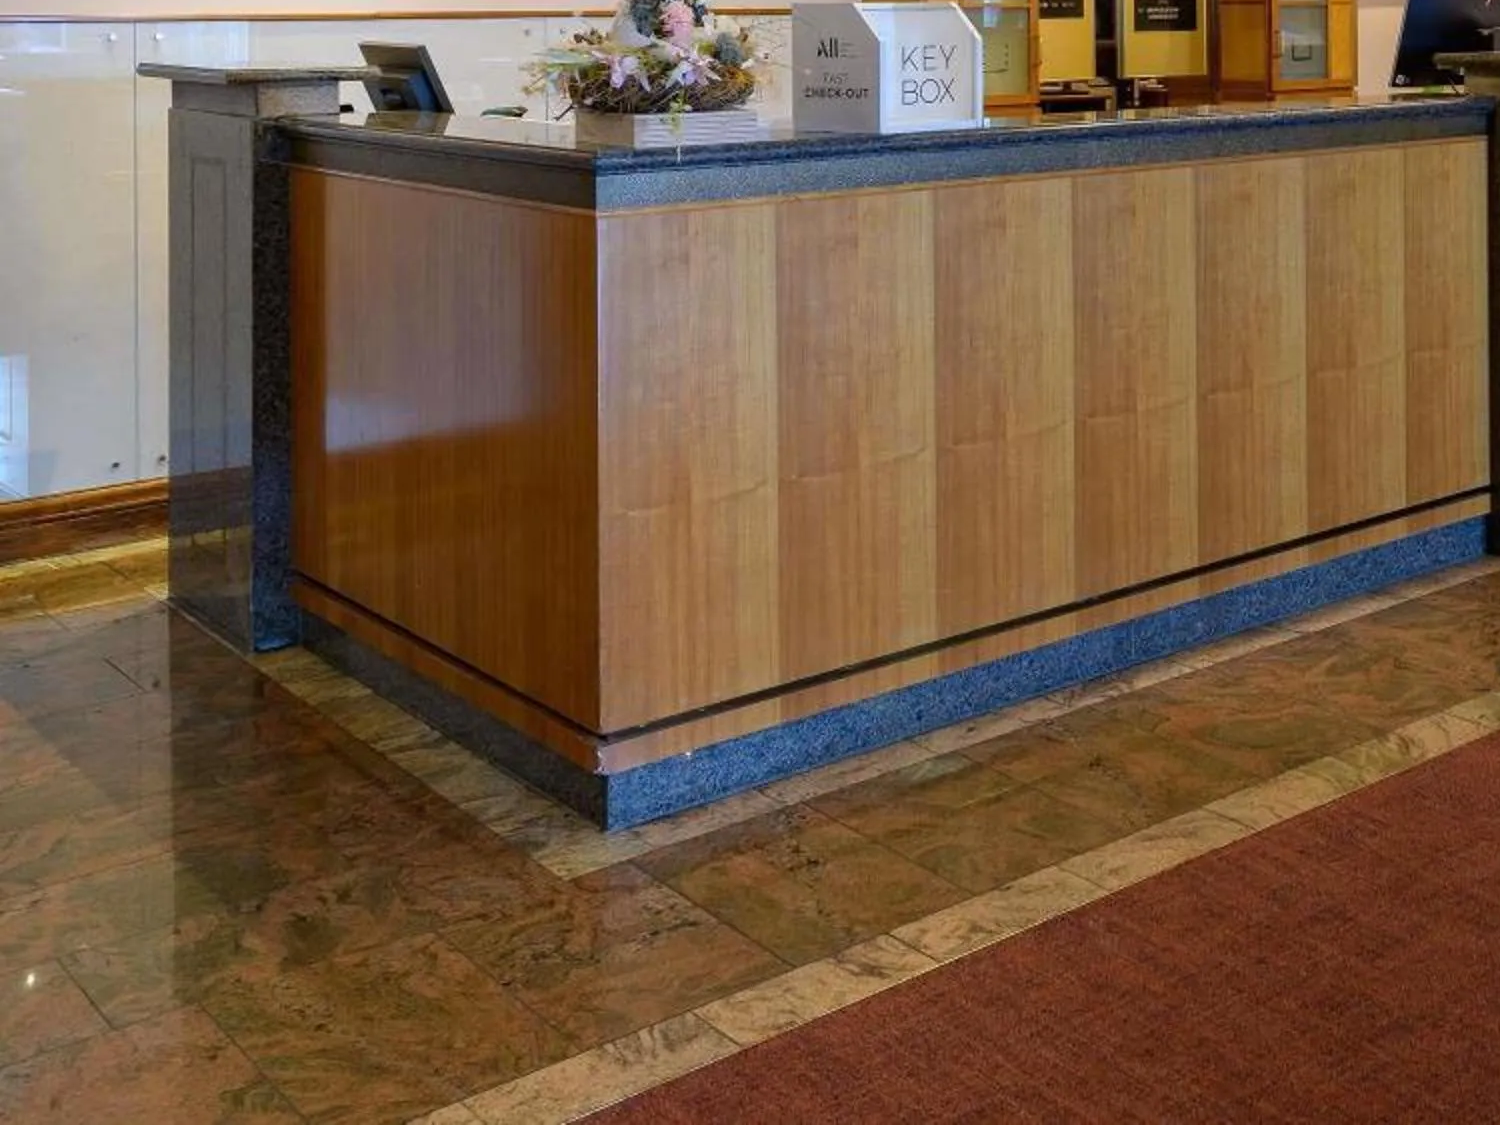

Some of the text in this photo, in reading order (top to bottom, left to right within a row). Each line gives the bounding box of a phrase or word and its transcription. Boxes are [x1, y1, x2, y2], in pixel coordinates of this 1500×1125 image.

[902, 45, 956, 71] KEY
[803, 86, 869, 99] CHECK-OUT
[902, 78, 955, 105] BOX
